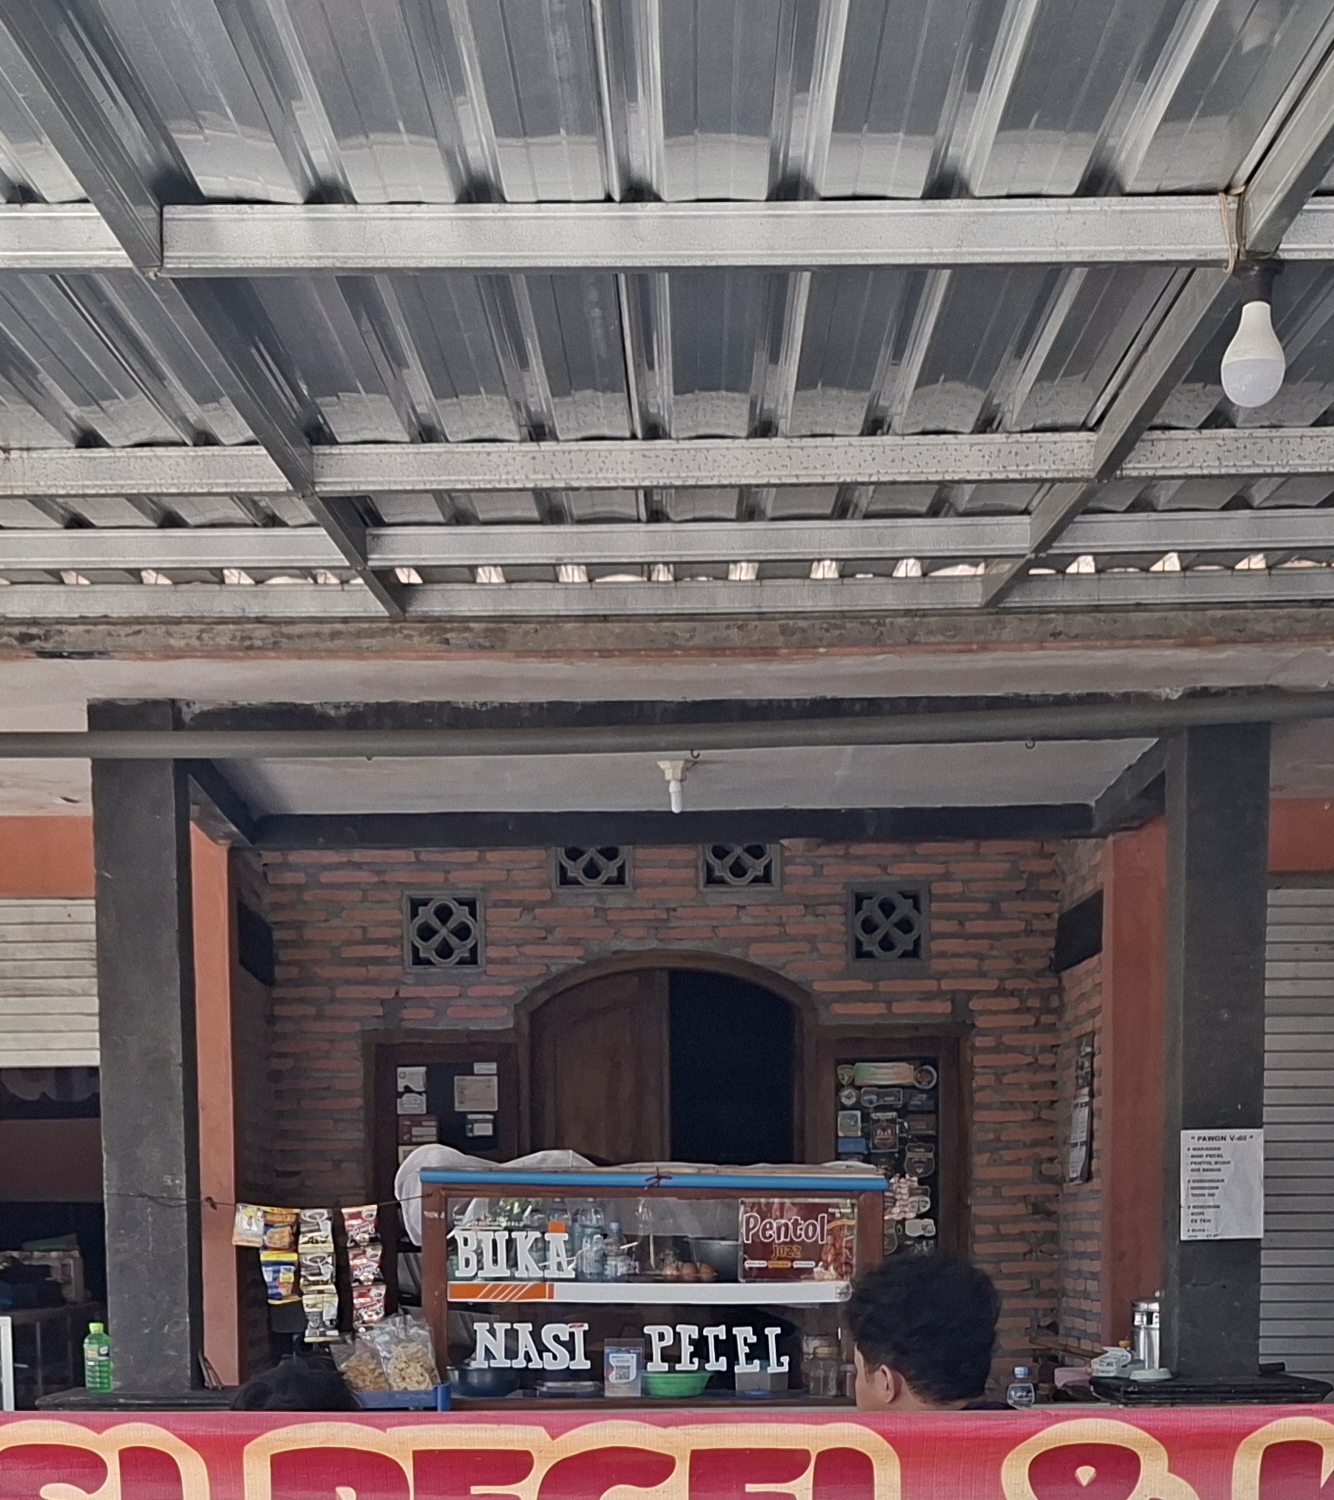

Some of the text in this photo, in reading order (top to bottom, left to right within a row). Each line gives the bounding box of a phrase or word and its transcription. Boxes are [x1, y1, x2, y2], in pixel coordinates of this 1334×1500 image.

[743, 1213, 828, 1244] Pentol
[454, 1230, 575, 1279] BUKA
[470, 1322, 592, 1371] NASI
[643, 1324, 790, 1374] PECEL
